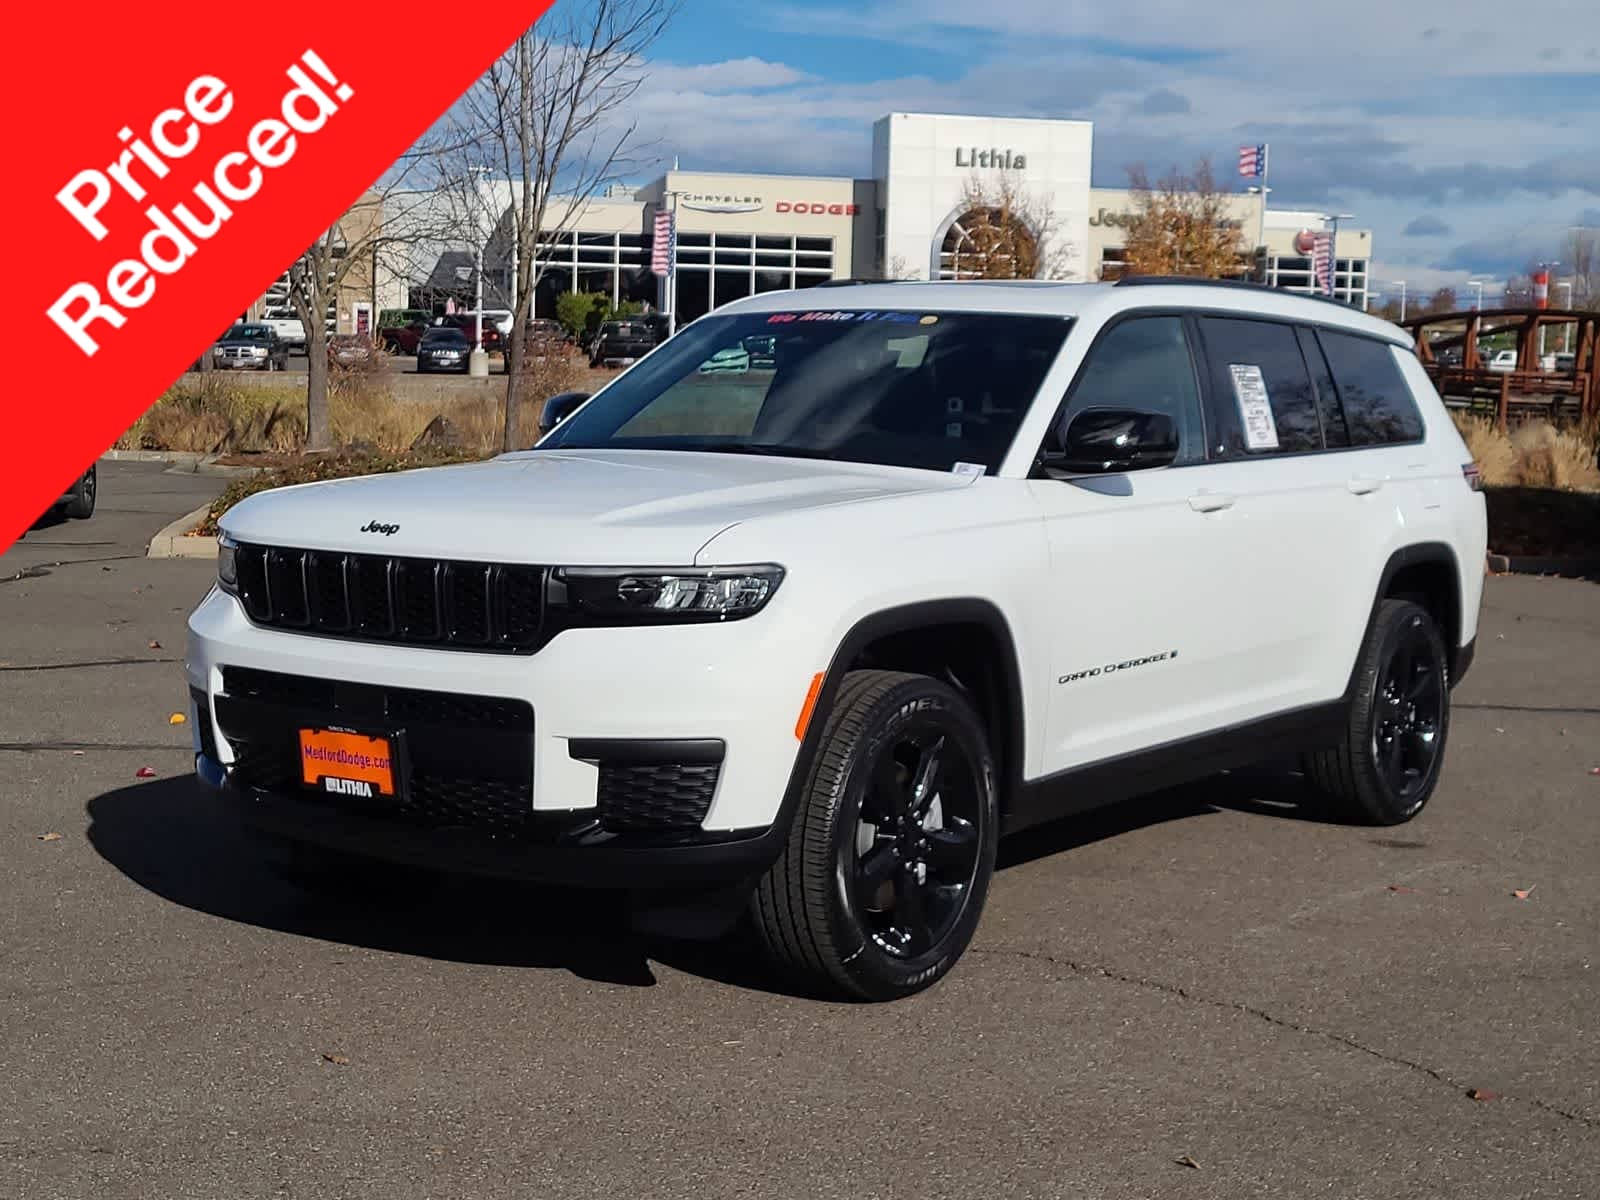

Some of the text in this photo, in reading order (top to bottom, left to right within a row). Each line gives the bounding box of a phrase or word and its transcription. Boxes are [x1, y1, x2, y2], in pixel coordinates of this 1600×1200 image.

[955, 146, 1027, 170] Lithia
[683, 193, 762, 204] CHRYSLER
[776, 201, 861, 216] DODGE
[799, 311, 855, 321] Make
[360, 519, 400, 537] Jeep
[1058, 667, 1101, 684] GRAND
[1103, 651, 1169, 673] CHEROKEE
[336, 778, 373, 798] LITHIA
